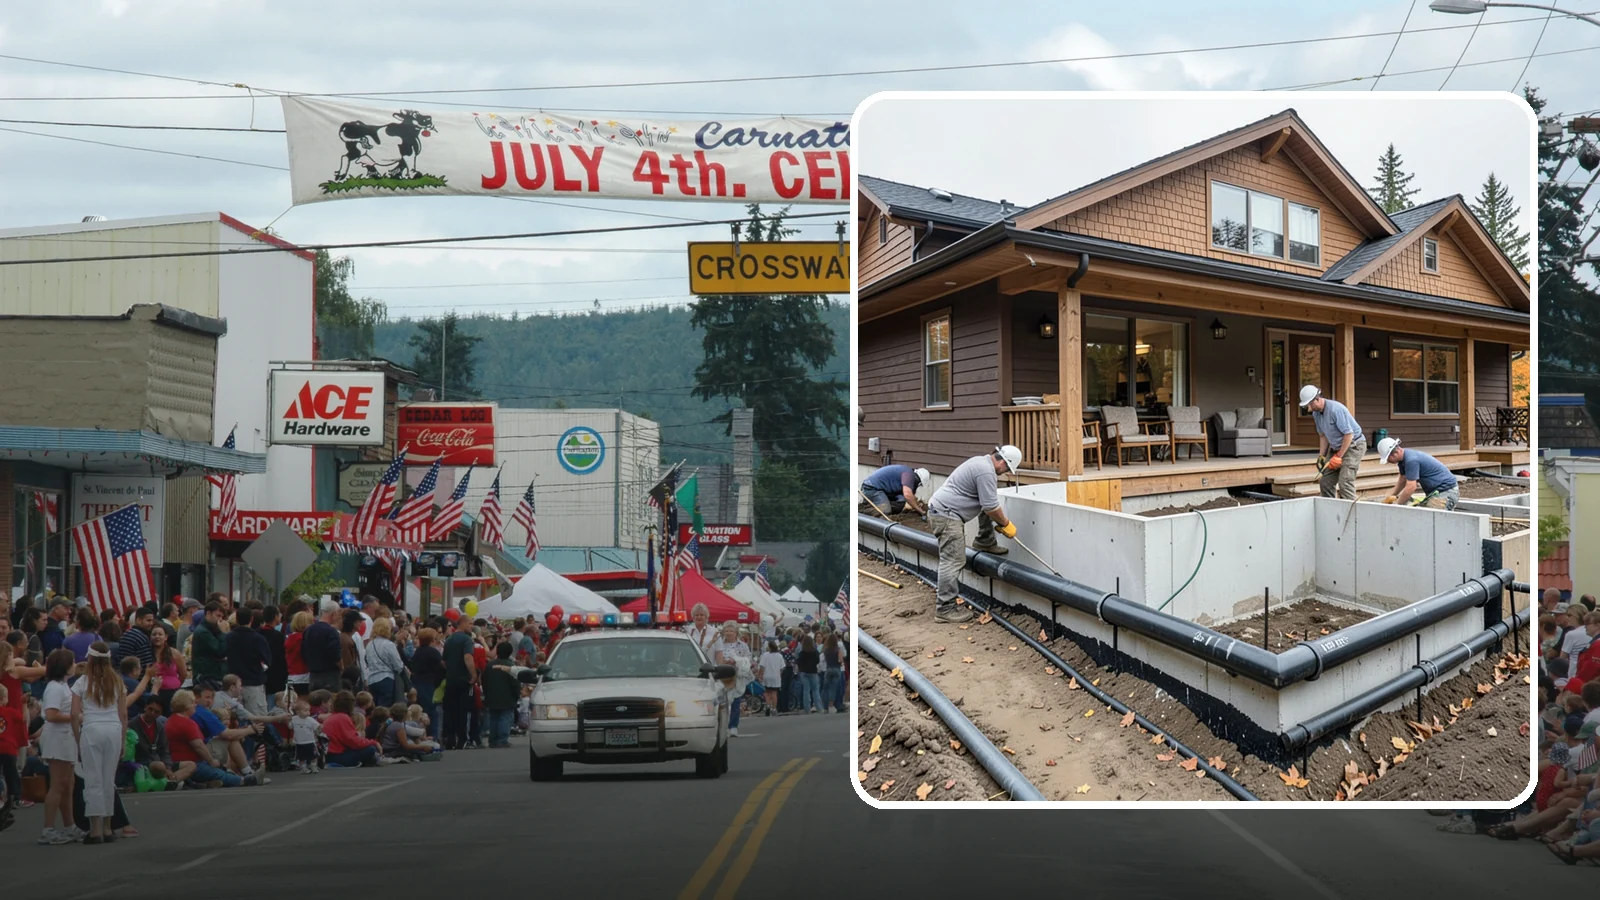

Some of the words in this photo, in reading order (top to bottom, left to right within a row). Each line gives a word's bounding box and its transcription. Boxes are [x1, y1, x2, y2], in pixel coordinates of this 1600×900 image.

[481, 141, 604, 192] JULY
[632, 150, 746, 197] 4th.
[697, 254, 850, 280] CROSSWA
[283, 380, 373, 420] ACE
[406, 409, 453, 422] CEDAR
[461, 409, 485, 422] LOG
[283, 421, 371, 436] Hardware
[416, 428, 477, 447] Coca-Cola
[353, 467, 385, 480] Simpl
[83, 485, 94, 494] St.
[96, 485, 124, 494] Vincent
[126, 486, 135, 494] de
[138, 487, 155, 495] Paul
[688, 527, 741, 535] CRNATION
[699, 535, 730, 543] GLASS
